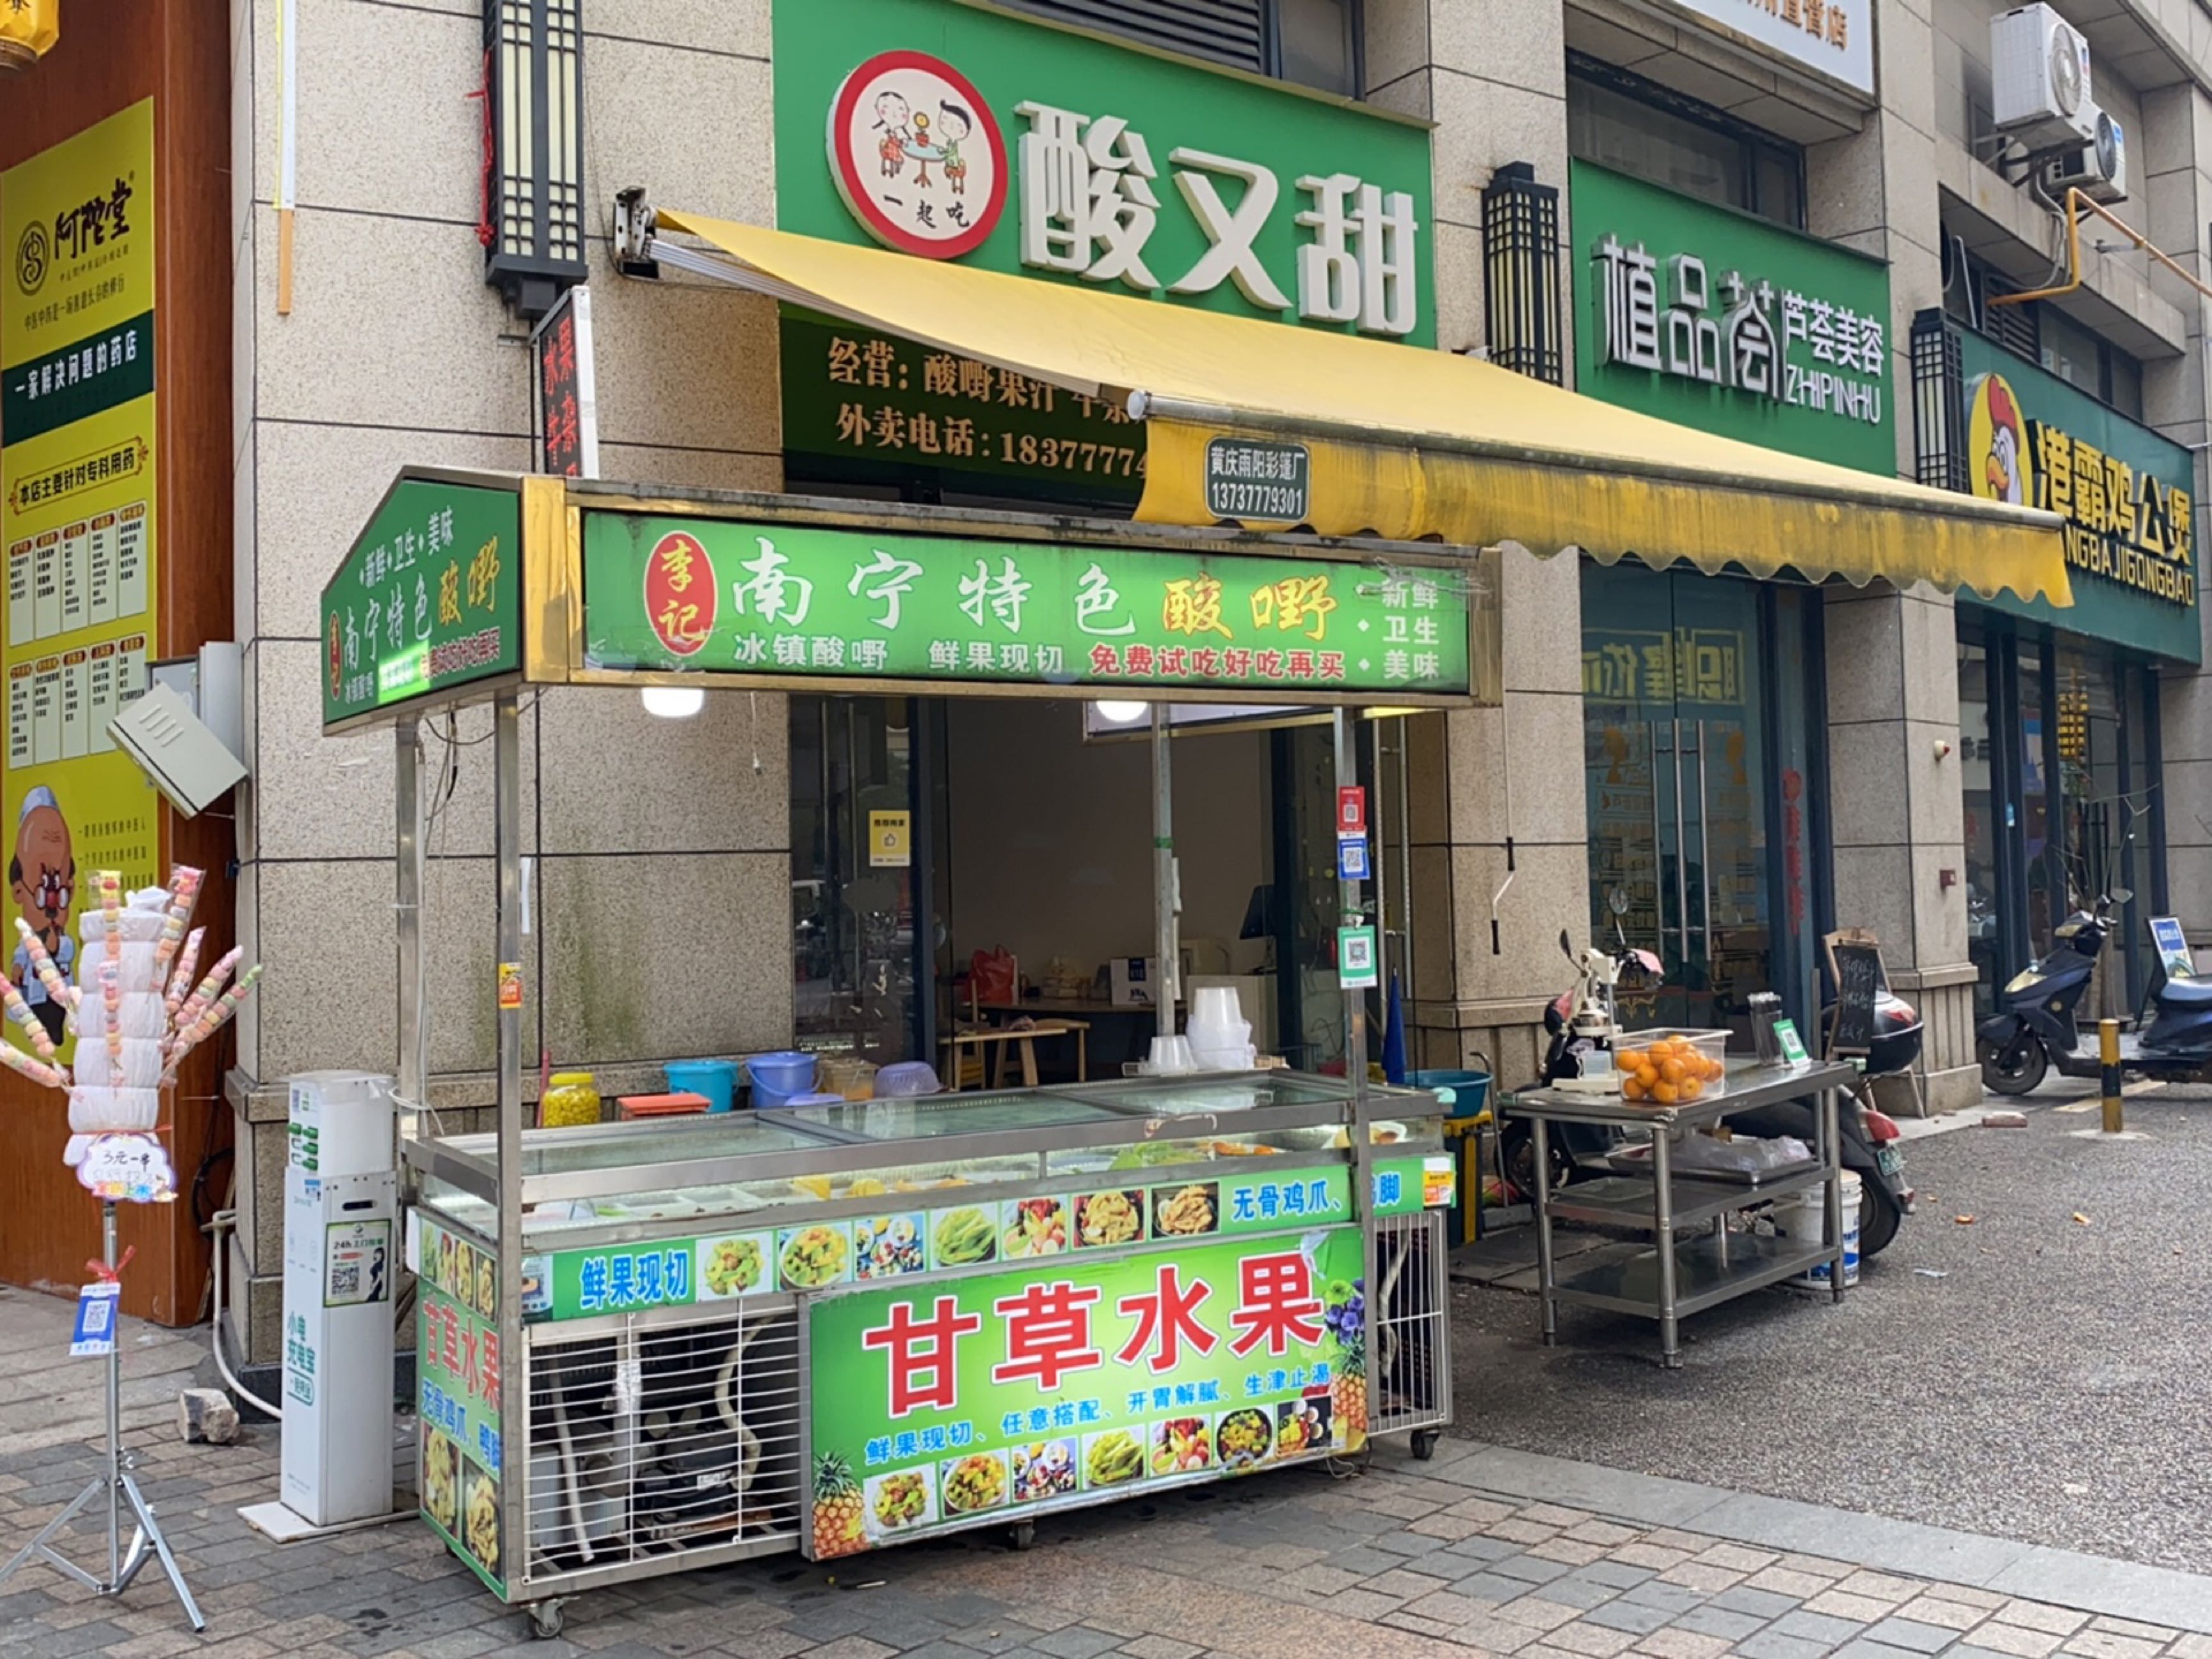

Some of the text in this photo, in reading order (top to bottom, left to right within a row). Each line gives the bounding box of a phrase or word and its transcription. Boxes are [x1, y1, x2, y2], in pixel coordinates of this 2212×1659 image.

[884, 195, 972, 229] 一起吃
[1013, 100, 1418, 335] 酸又甜
[1784, 289, 1884, 377] 芦荟美容
[1212, 482, 1302, 515] 13737779301
[659, 539, 704, 641] 李记
[1382, 579, 1439, 609] 新鲜
[734, 635, 1346, 679] 冰镇酸嘢 鲜果现切 免费试吃好吃再买
[1382, 618, 1439, 646] 卫生
[1382, 650, 1439, 680] 美味
[580, 1248, 689, 1310] 鲜果现切
[422, 1293, 499, 1416] 甘草水果
[862, 1251, 1324, 1418] 甘草水果
